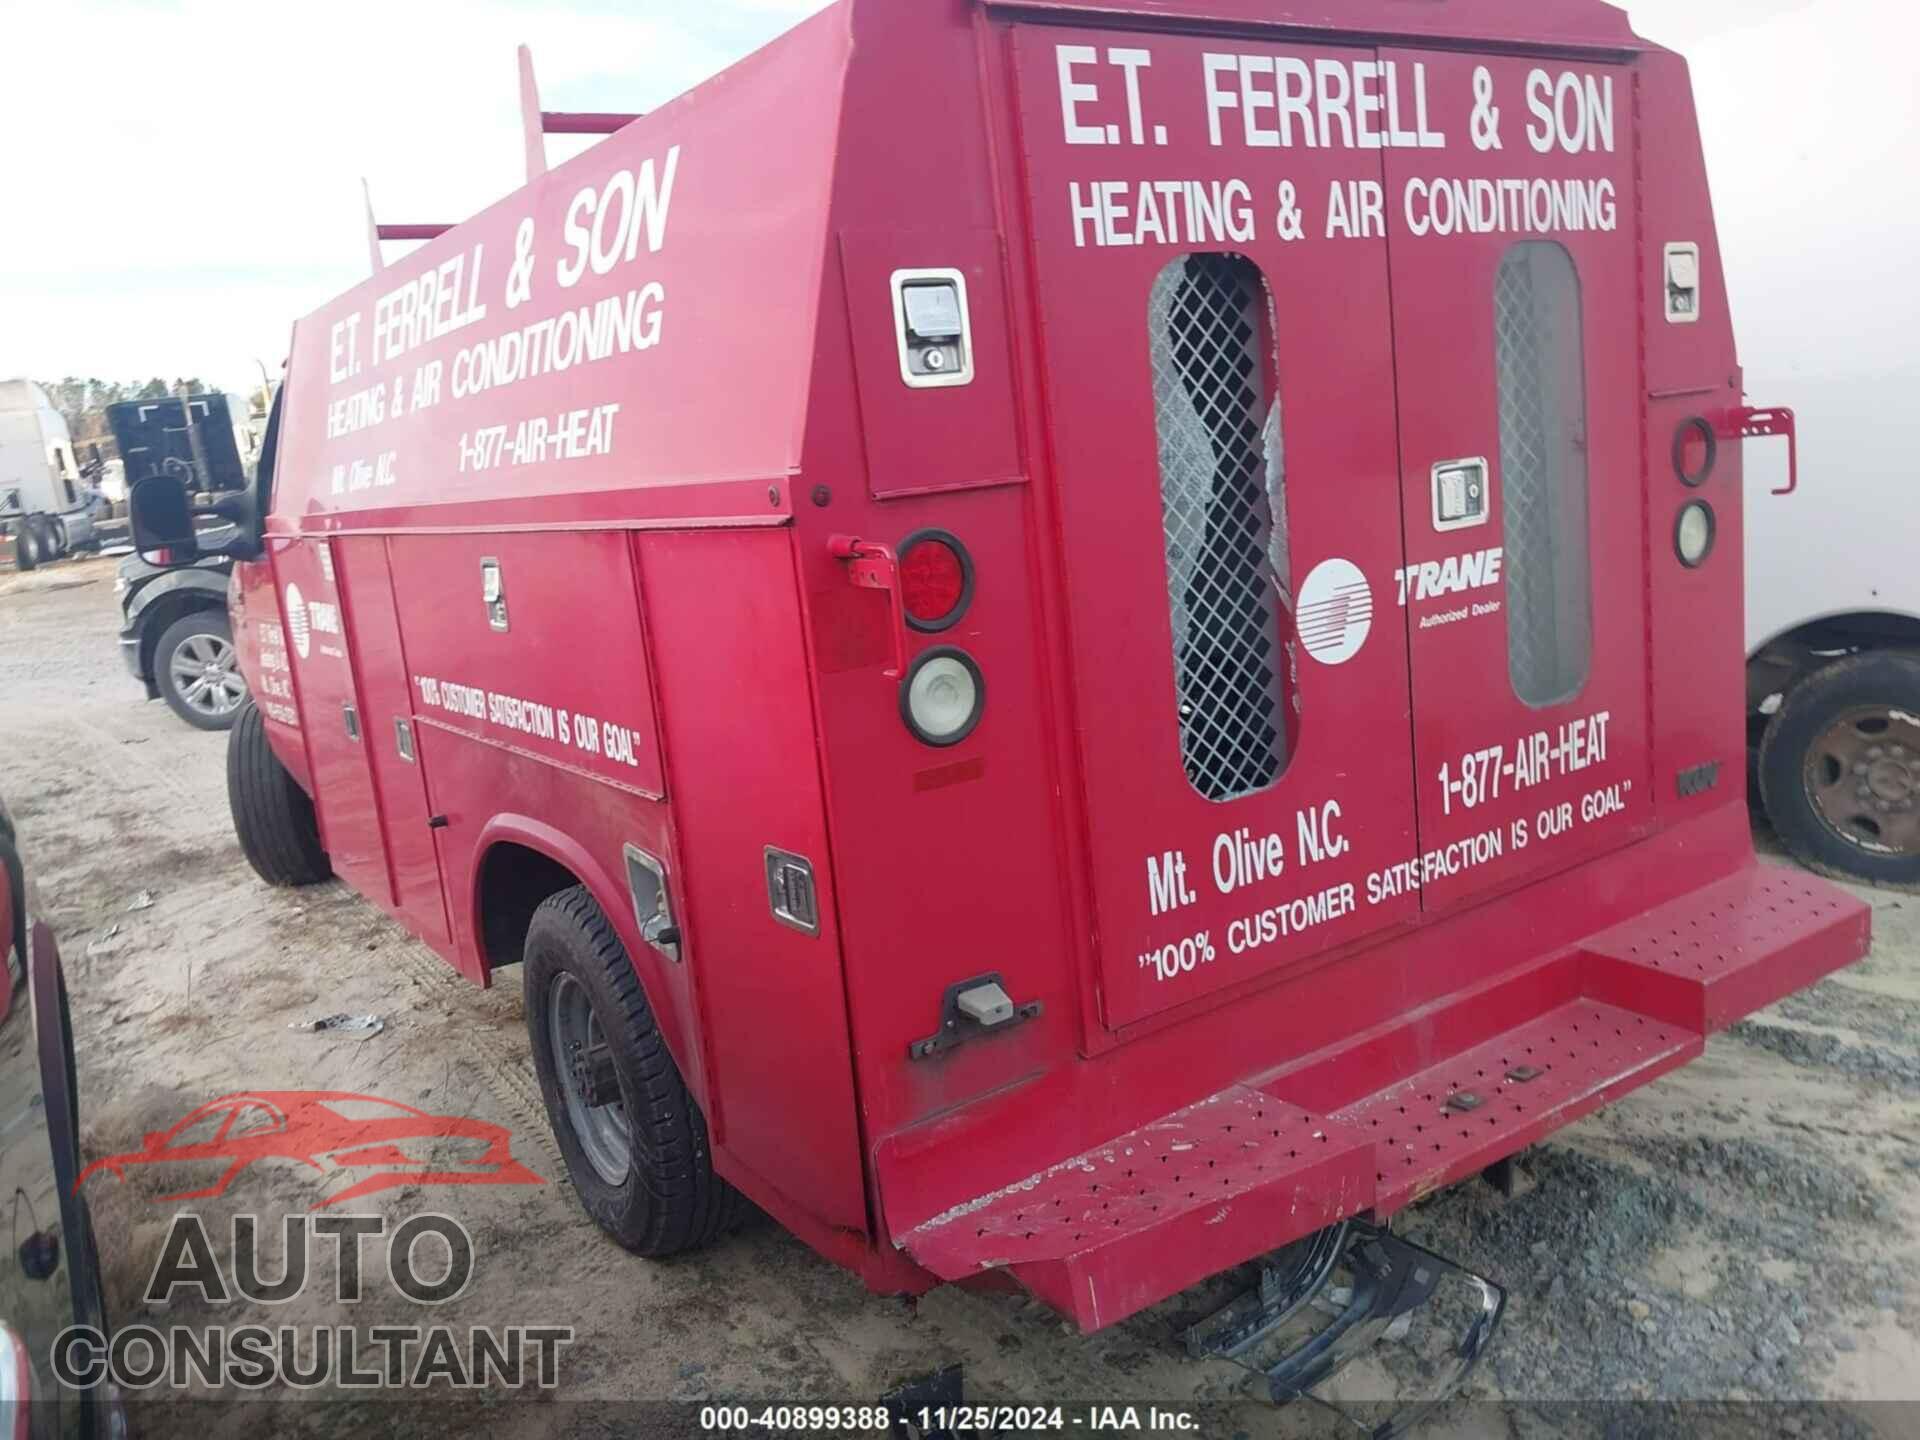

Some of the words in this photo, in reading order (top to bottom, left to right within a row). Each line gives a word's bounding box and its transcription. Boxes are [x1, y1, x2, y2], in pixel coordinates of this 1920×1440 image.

[1055, 45, 1168, 146] E.T.
[1202, 52, 1446, 150] FERRELL
[1469, 65, 1503, 151] &
[1526, 68, 1615, 153] SON
[373, 243, 487, 367] FERRELL
[505, 216, 536, 310] &
[556, 144, 681, 288] SON
[1069, 179, 1255, 247] HEATING
[1276, 180, 1305, 241] &
[1326, 181, 1386, 238] AIR
[1403, 177, 1616, 237] CONDITIONING
[327, 382, 386, 439] HEATING
[391, 375, 403, 418] &
[410, 360, 442, 415] AIR
[451, 281, 665, 399] CONDITIONING
[459, 403, 620, 472] 1-877-AIR-HEAT
[1394, 546, 1503, 607] TRANE
[1419, 607, 1468, 629] Authorized
[1472, 600, 1501, 616] Dealer
[440, 681, 487, 720] CUSTOMER
[487, 691, 554, 740] SATISFACTION
[557, 708, 571, 745] IS
[574, 713, 600, 753] OUR
[1437, 711, 1610, 815] 1-877-AIR-HEAT
[1147, 850, 1197, 916] Mt.
[1212, 826, 1284, 894] Olive
[1296, 799, 1350, 866] N.C.
[1227, 883, 1355, 954] CUSTOMER
[1366, 828, 1503, 906] SATISFACTION
[1512, 819, 1528, 850] IS
[1537, 803, 1574, 841] OUR
